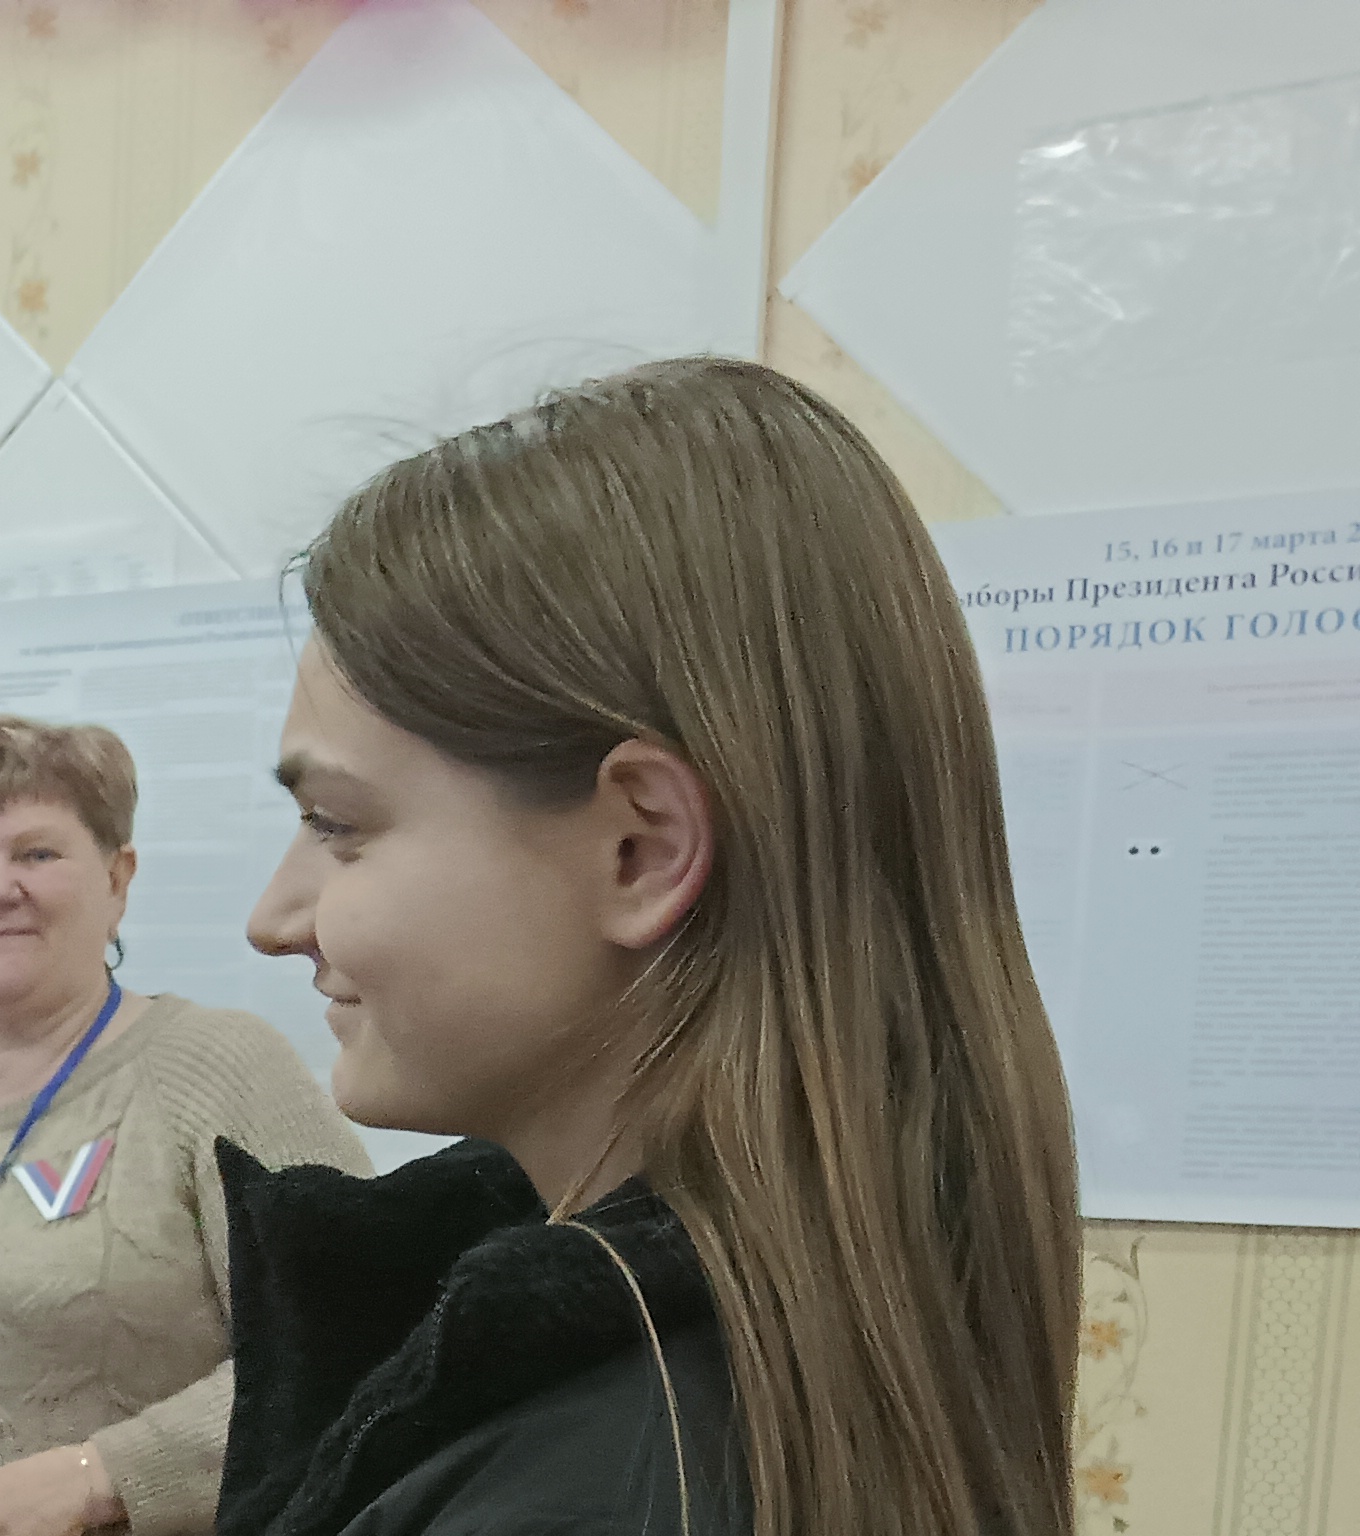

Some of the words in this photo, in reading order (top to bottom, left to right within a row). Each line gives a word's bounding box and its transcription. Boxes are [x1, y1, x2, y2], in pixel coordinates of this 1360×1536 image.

[1150, 538, 1179, 559] 16
[1186, 540, 1203, 557] и
[1215, 531, 1243, 554] 17
[1251, 529, 1337, 556] марта
[959, 583, 1055, 613] ыборы
[1066, 571, 1257, 609] Президента
[1004, 616, 1207, 654] ПОРЯДОК
